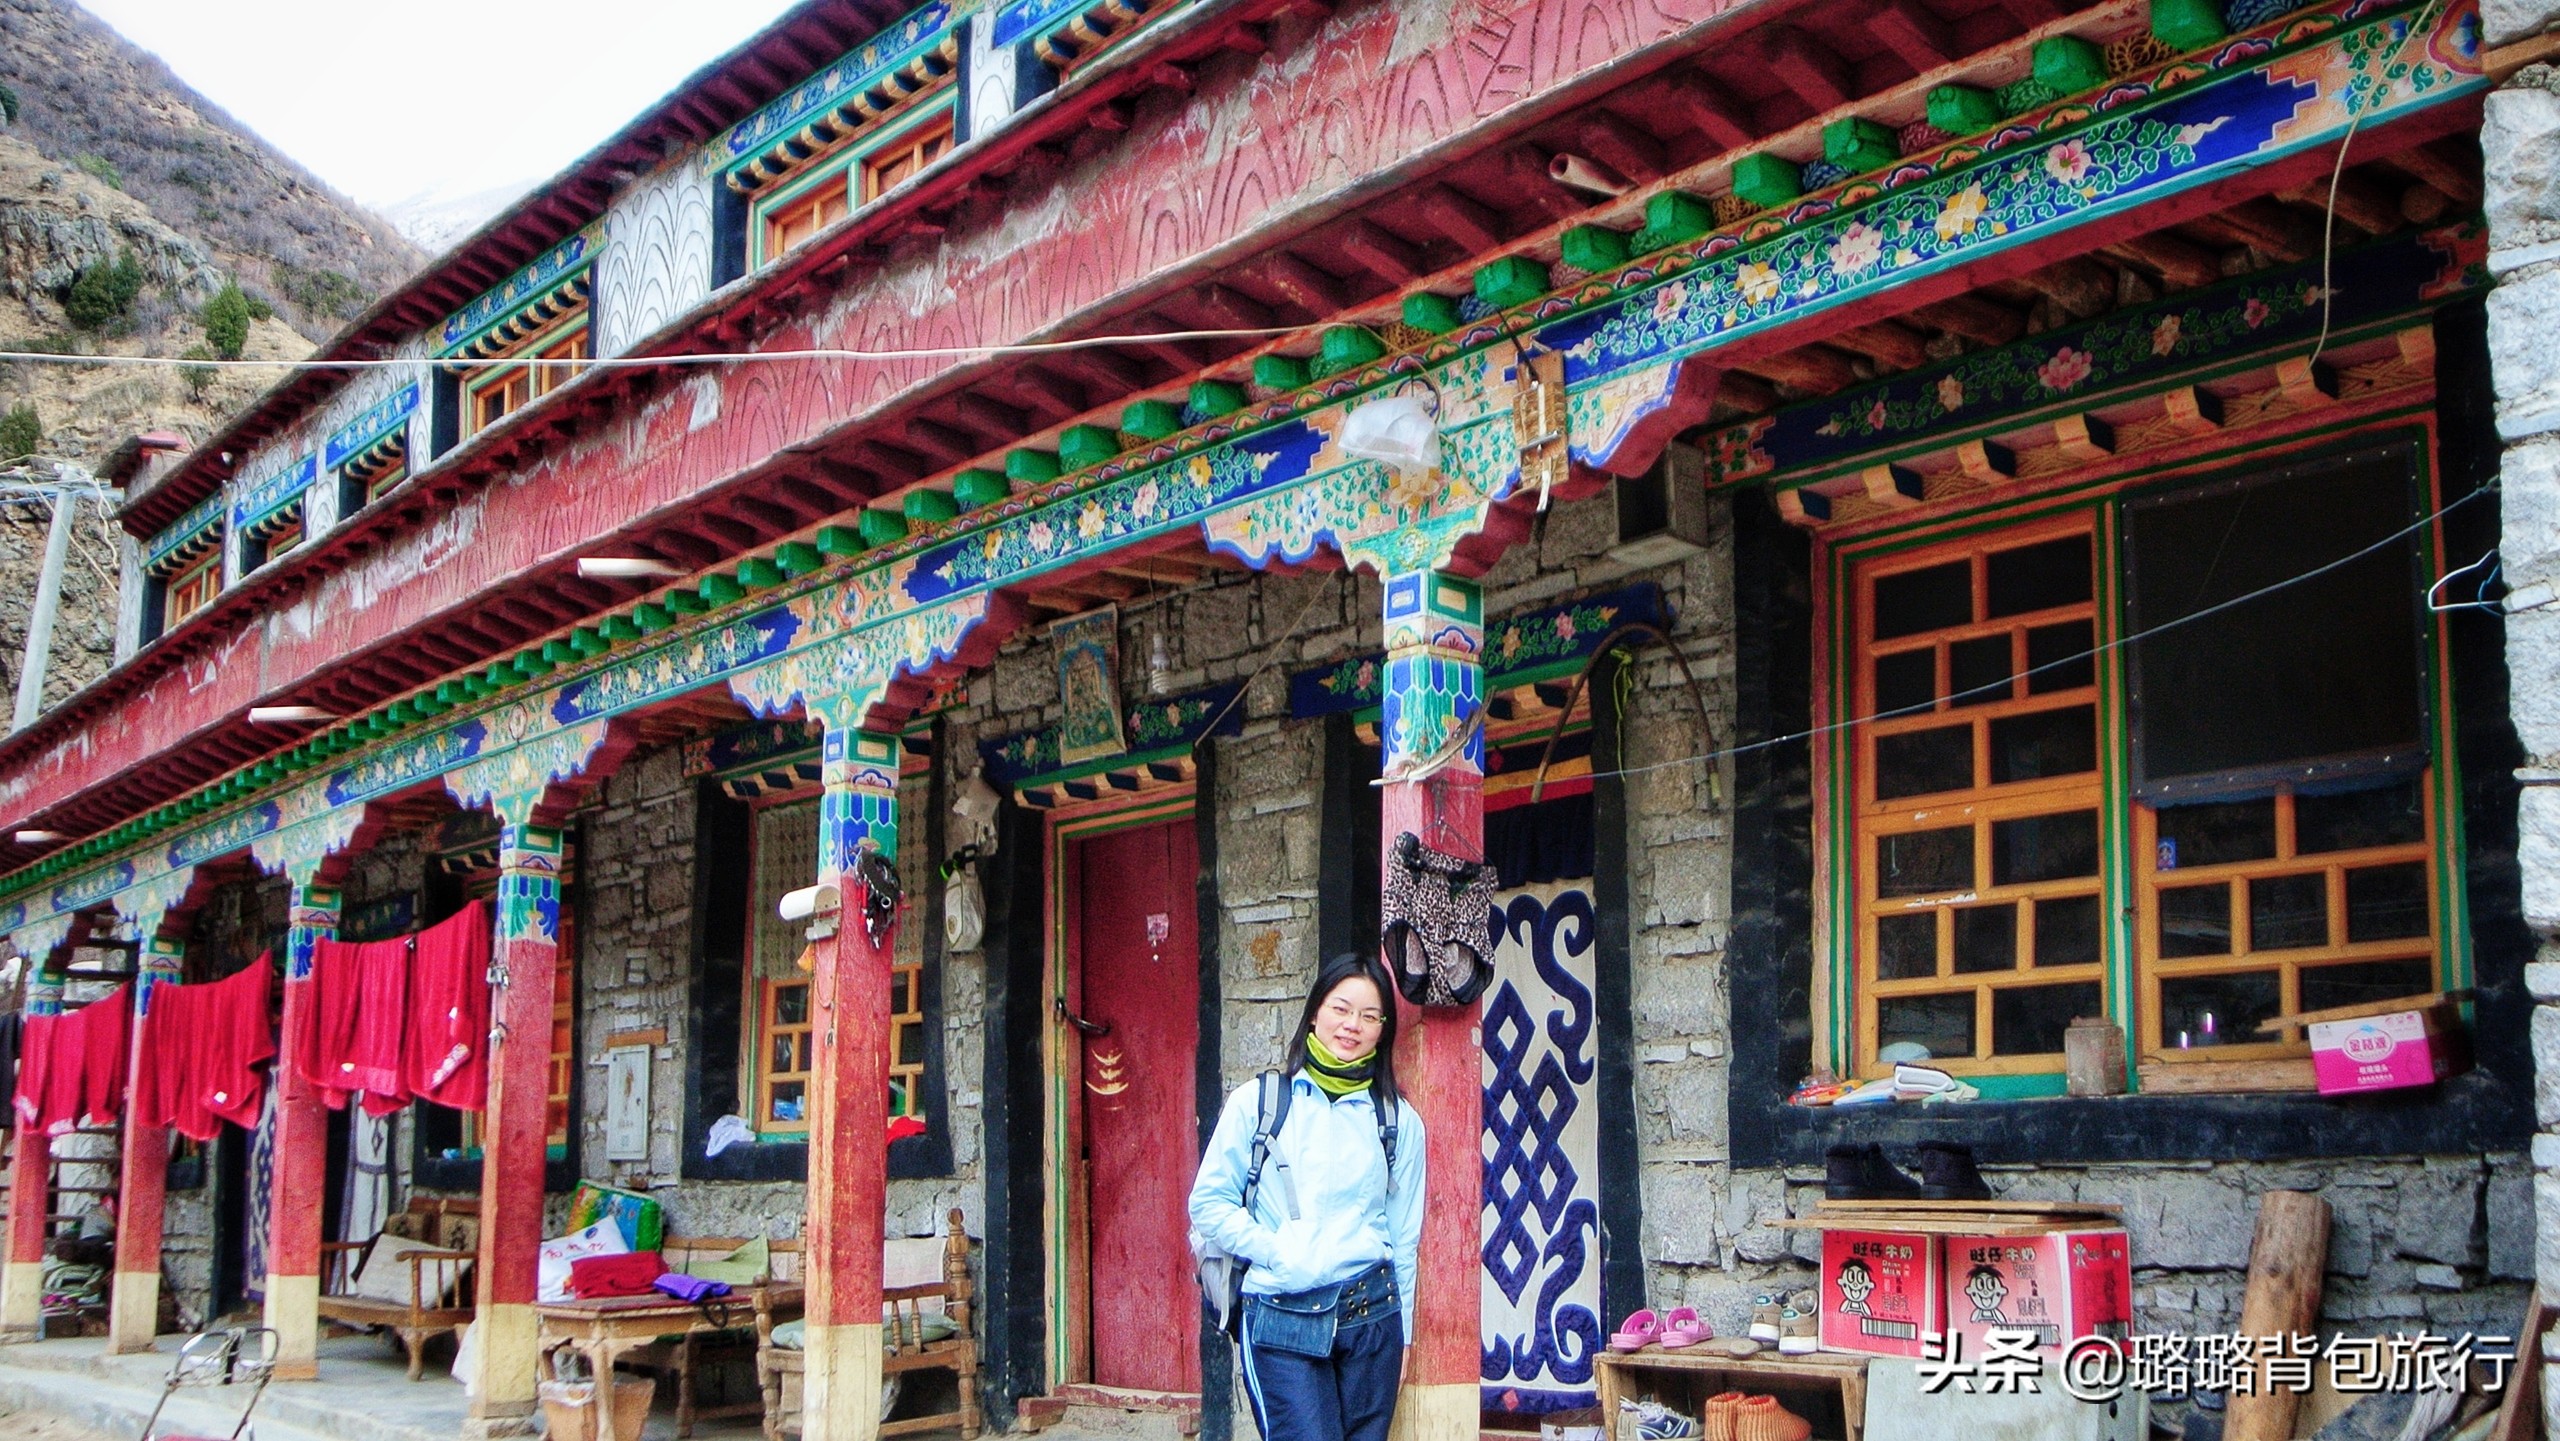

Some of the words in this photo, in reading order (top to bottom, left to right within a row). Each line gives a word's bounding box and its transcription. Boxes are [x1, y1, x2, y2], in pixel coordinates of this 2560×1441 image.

[1853, 1241, 1913, 1260] 旺仔牛奶
[1969, 1245, 2037, 1263] 旺仔牛奶
